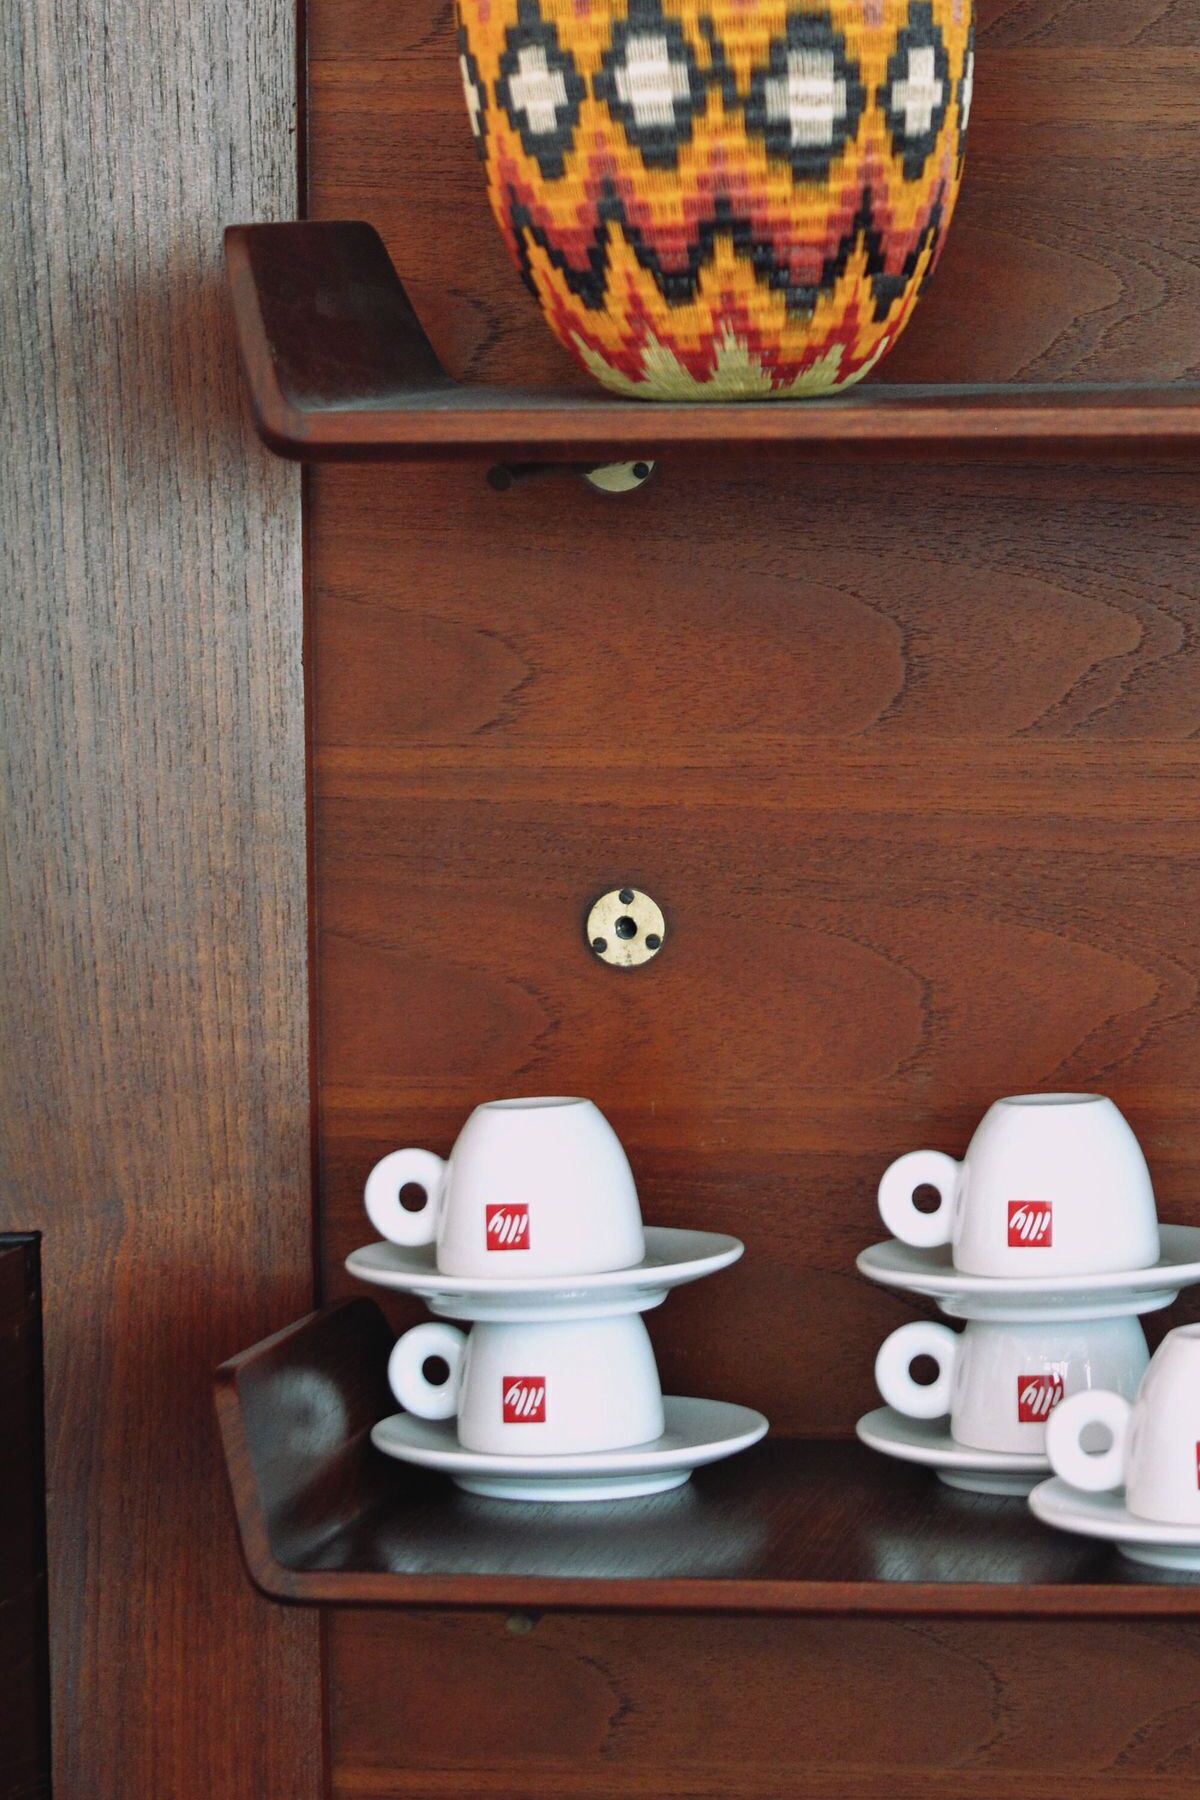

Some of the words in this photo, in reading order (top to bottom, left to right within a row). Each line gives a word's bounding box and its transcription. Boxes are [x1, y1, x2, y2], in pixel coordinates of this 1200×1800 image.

[488, 1205, 528, 1244] illy
[1009, 1204, 1051, 1240] illy
[504, 1380, 545, 1416] illy
